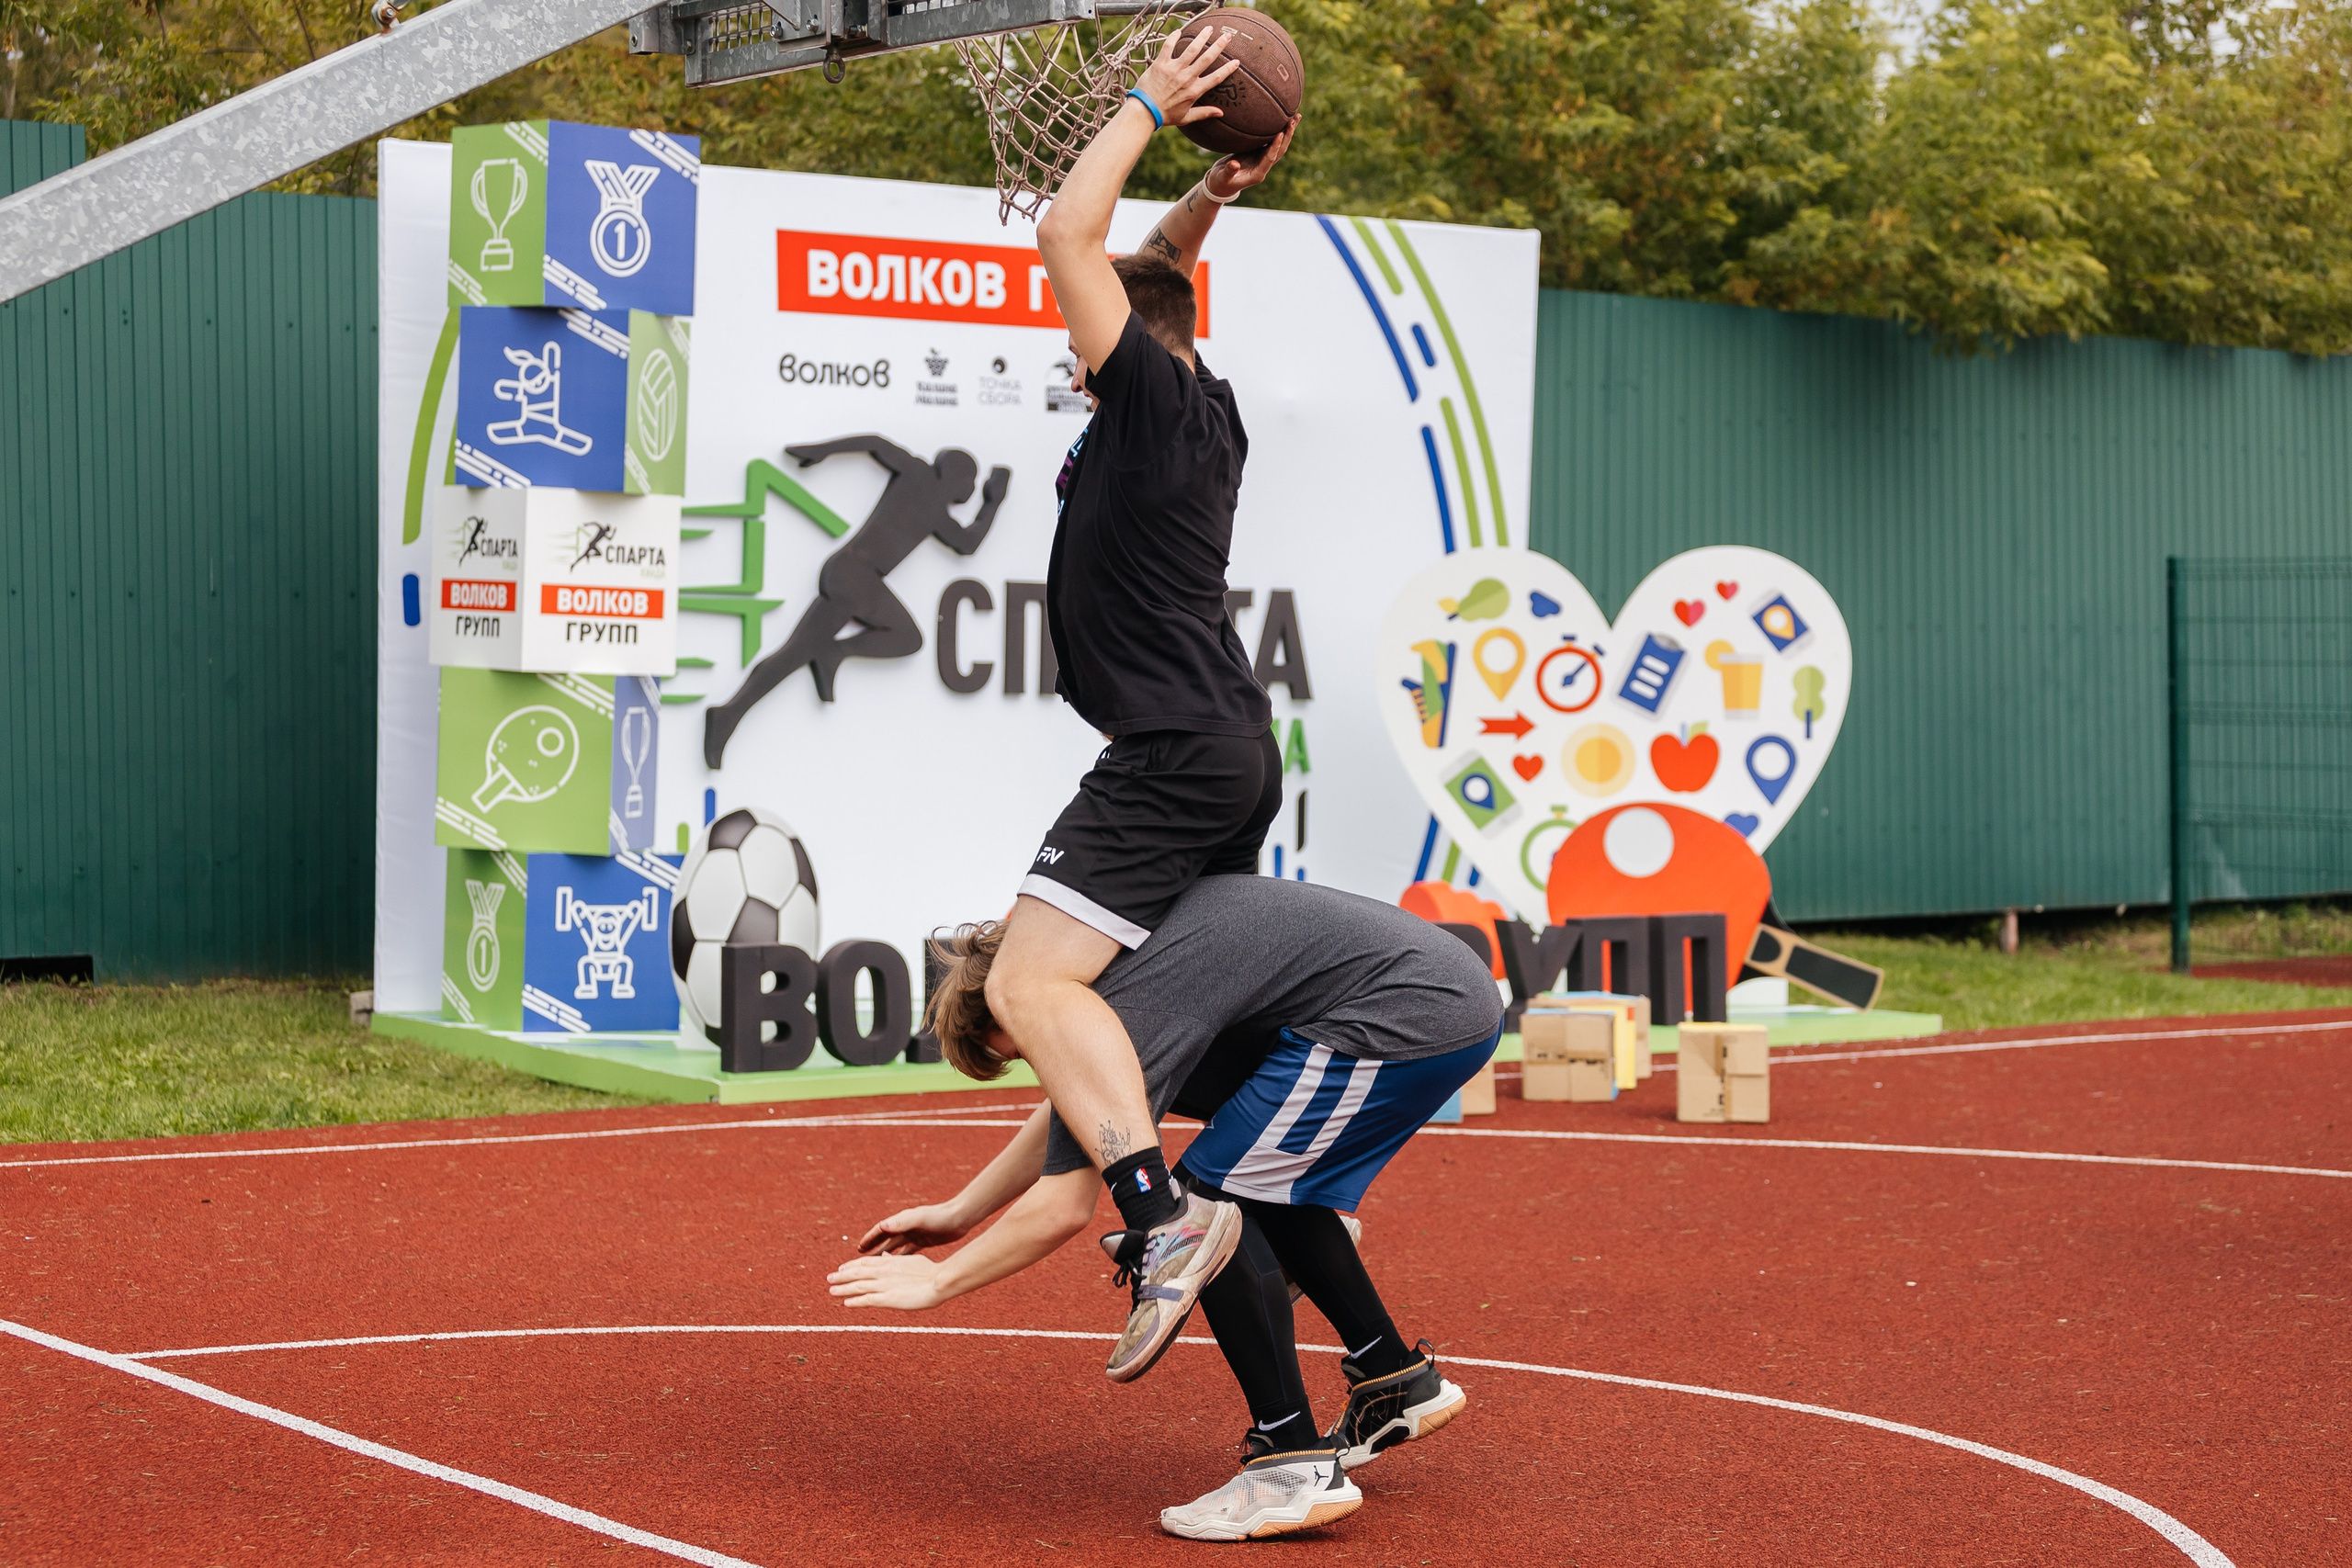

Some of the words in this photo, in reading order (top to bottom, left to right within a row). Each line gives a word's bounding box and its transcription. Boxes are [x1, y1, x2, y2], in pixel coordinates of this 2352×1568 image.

[808, 249, 1006, 309] ВОЛКОВ
[780, 354, 890, 387] волков
[481, 537, 518, 557] СПАРТА
[605, 545, 665, 566] СПАРТА
[450, 582, 507, 608] ВОЛКОВ
[557, 588, 649, 615] ВОЛКОВ
[456, 615, 500, 637] ГРУПП
[566, 622, 638, 644] ГРУПП
